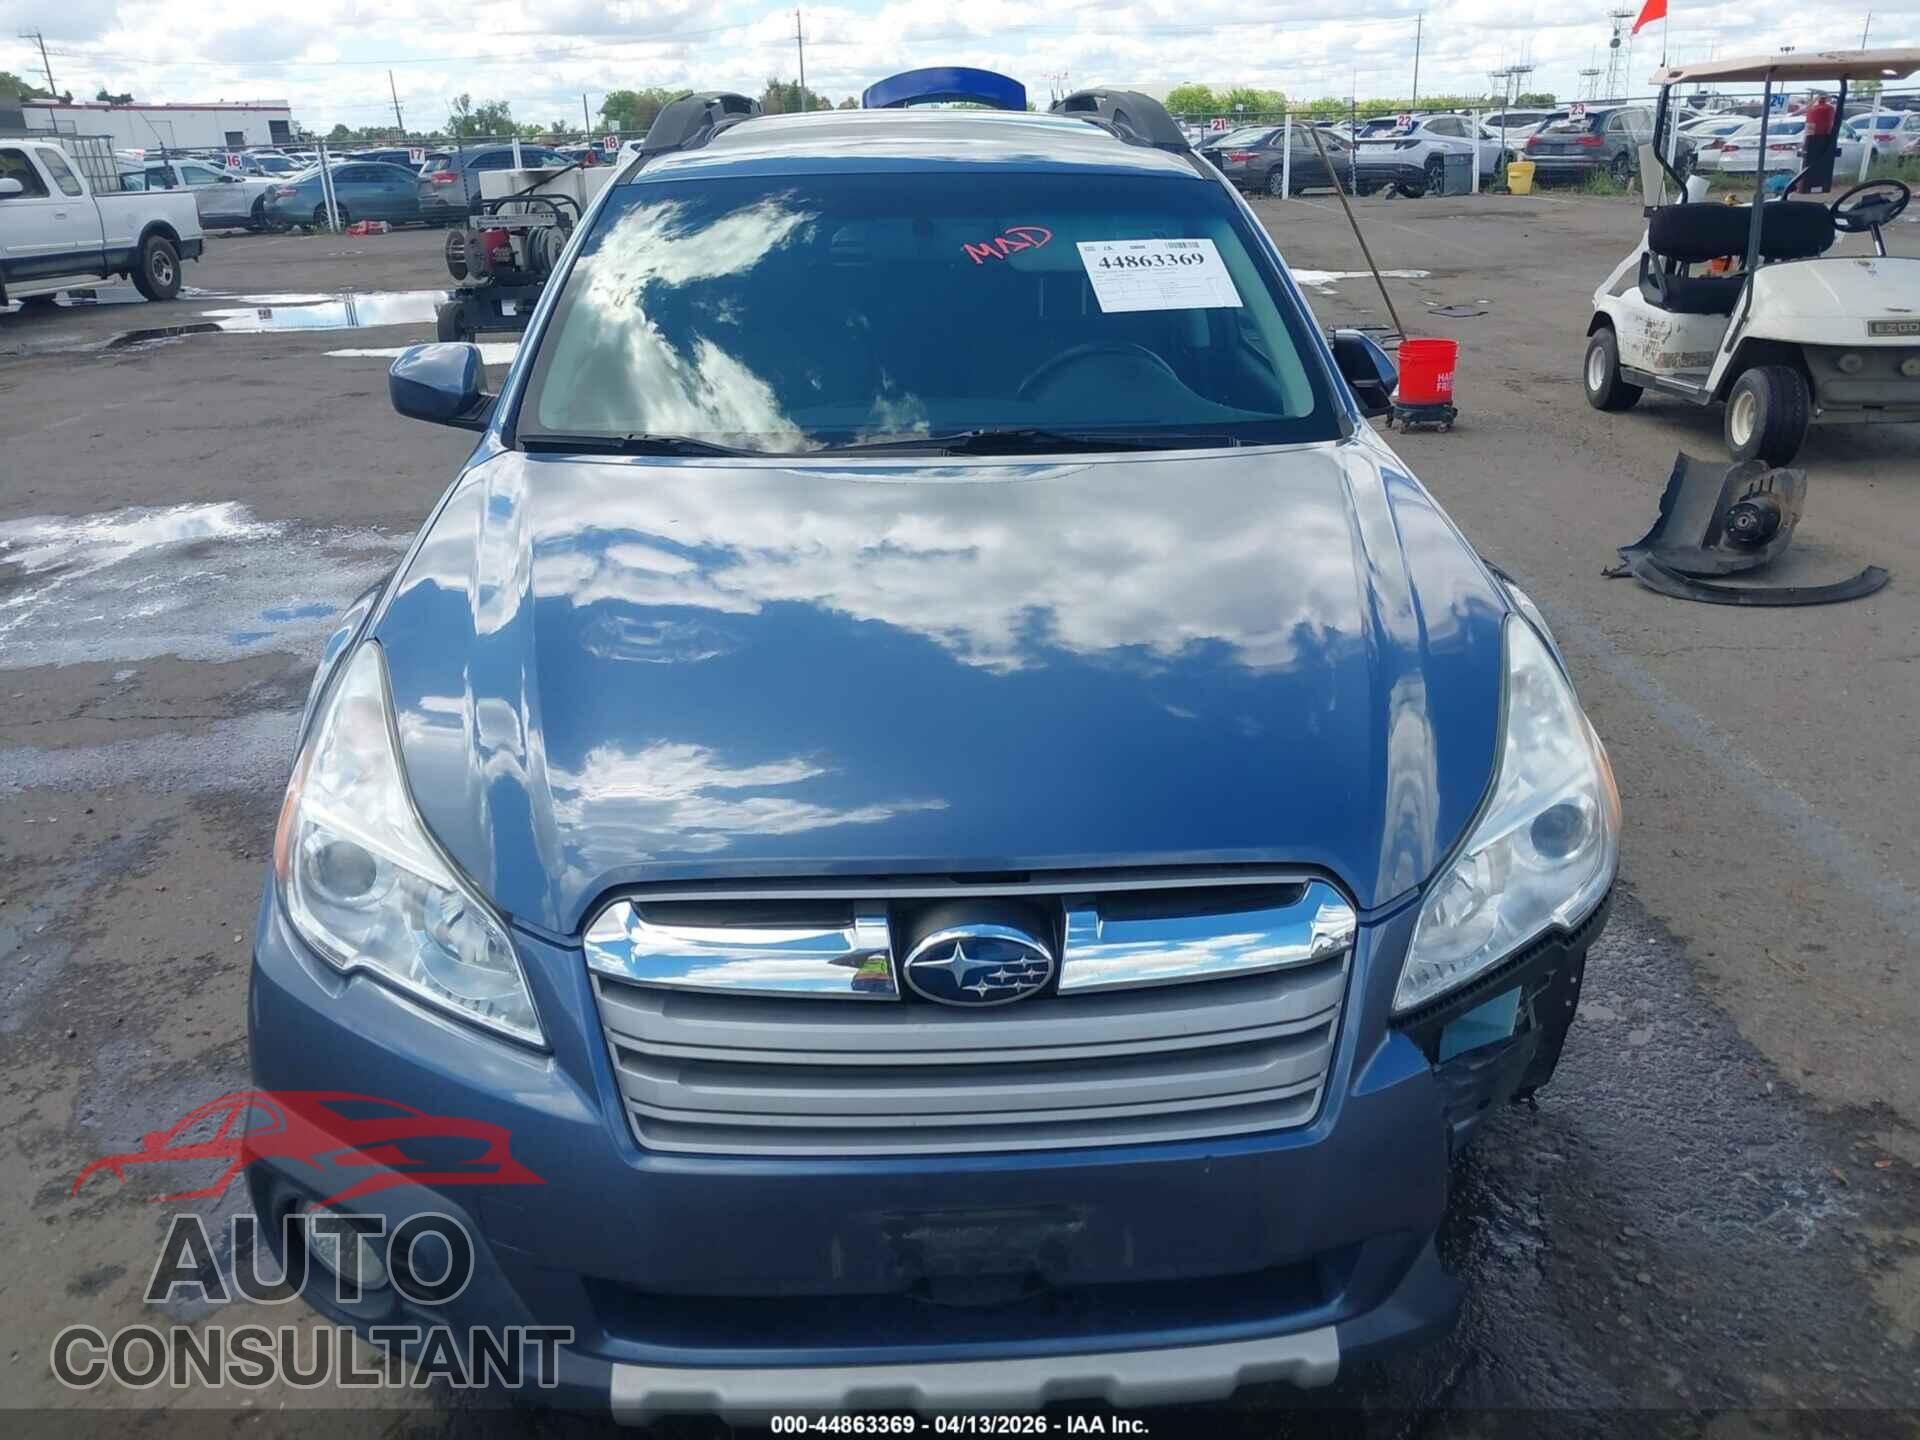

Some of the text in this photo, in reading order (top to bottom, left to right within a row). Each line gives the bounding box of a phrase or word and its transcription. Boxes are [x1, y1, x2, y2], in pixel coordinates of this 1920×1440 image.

[1769, 95, 1784, 108] 24
[1571, 103, 1584, 115] 23
[1212, 120, 1225, 130] 21
[1398, 115, 1411, 126] 22
[605, 137, 617, 148] 18
[410, 149, 422, 160] 17
[227, 155, 240, 167] 16
[1098, 252, 1205, 269] 44863369
